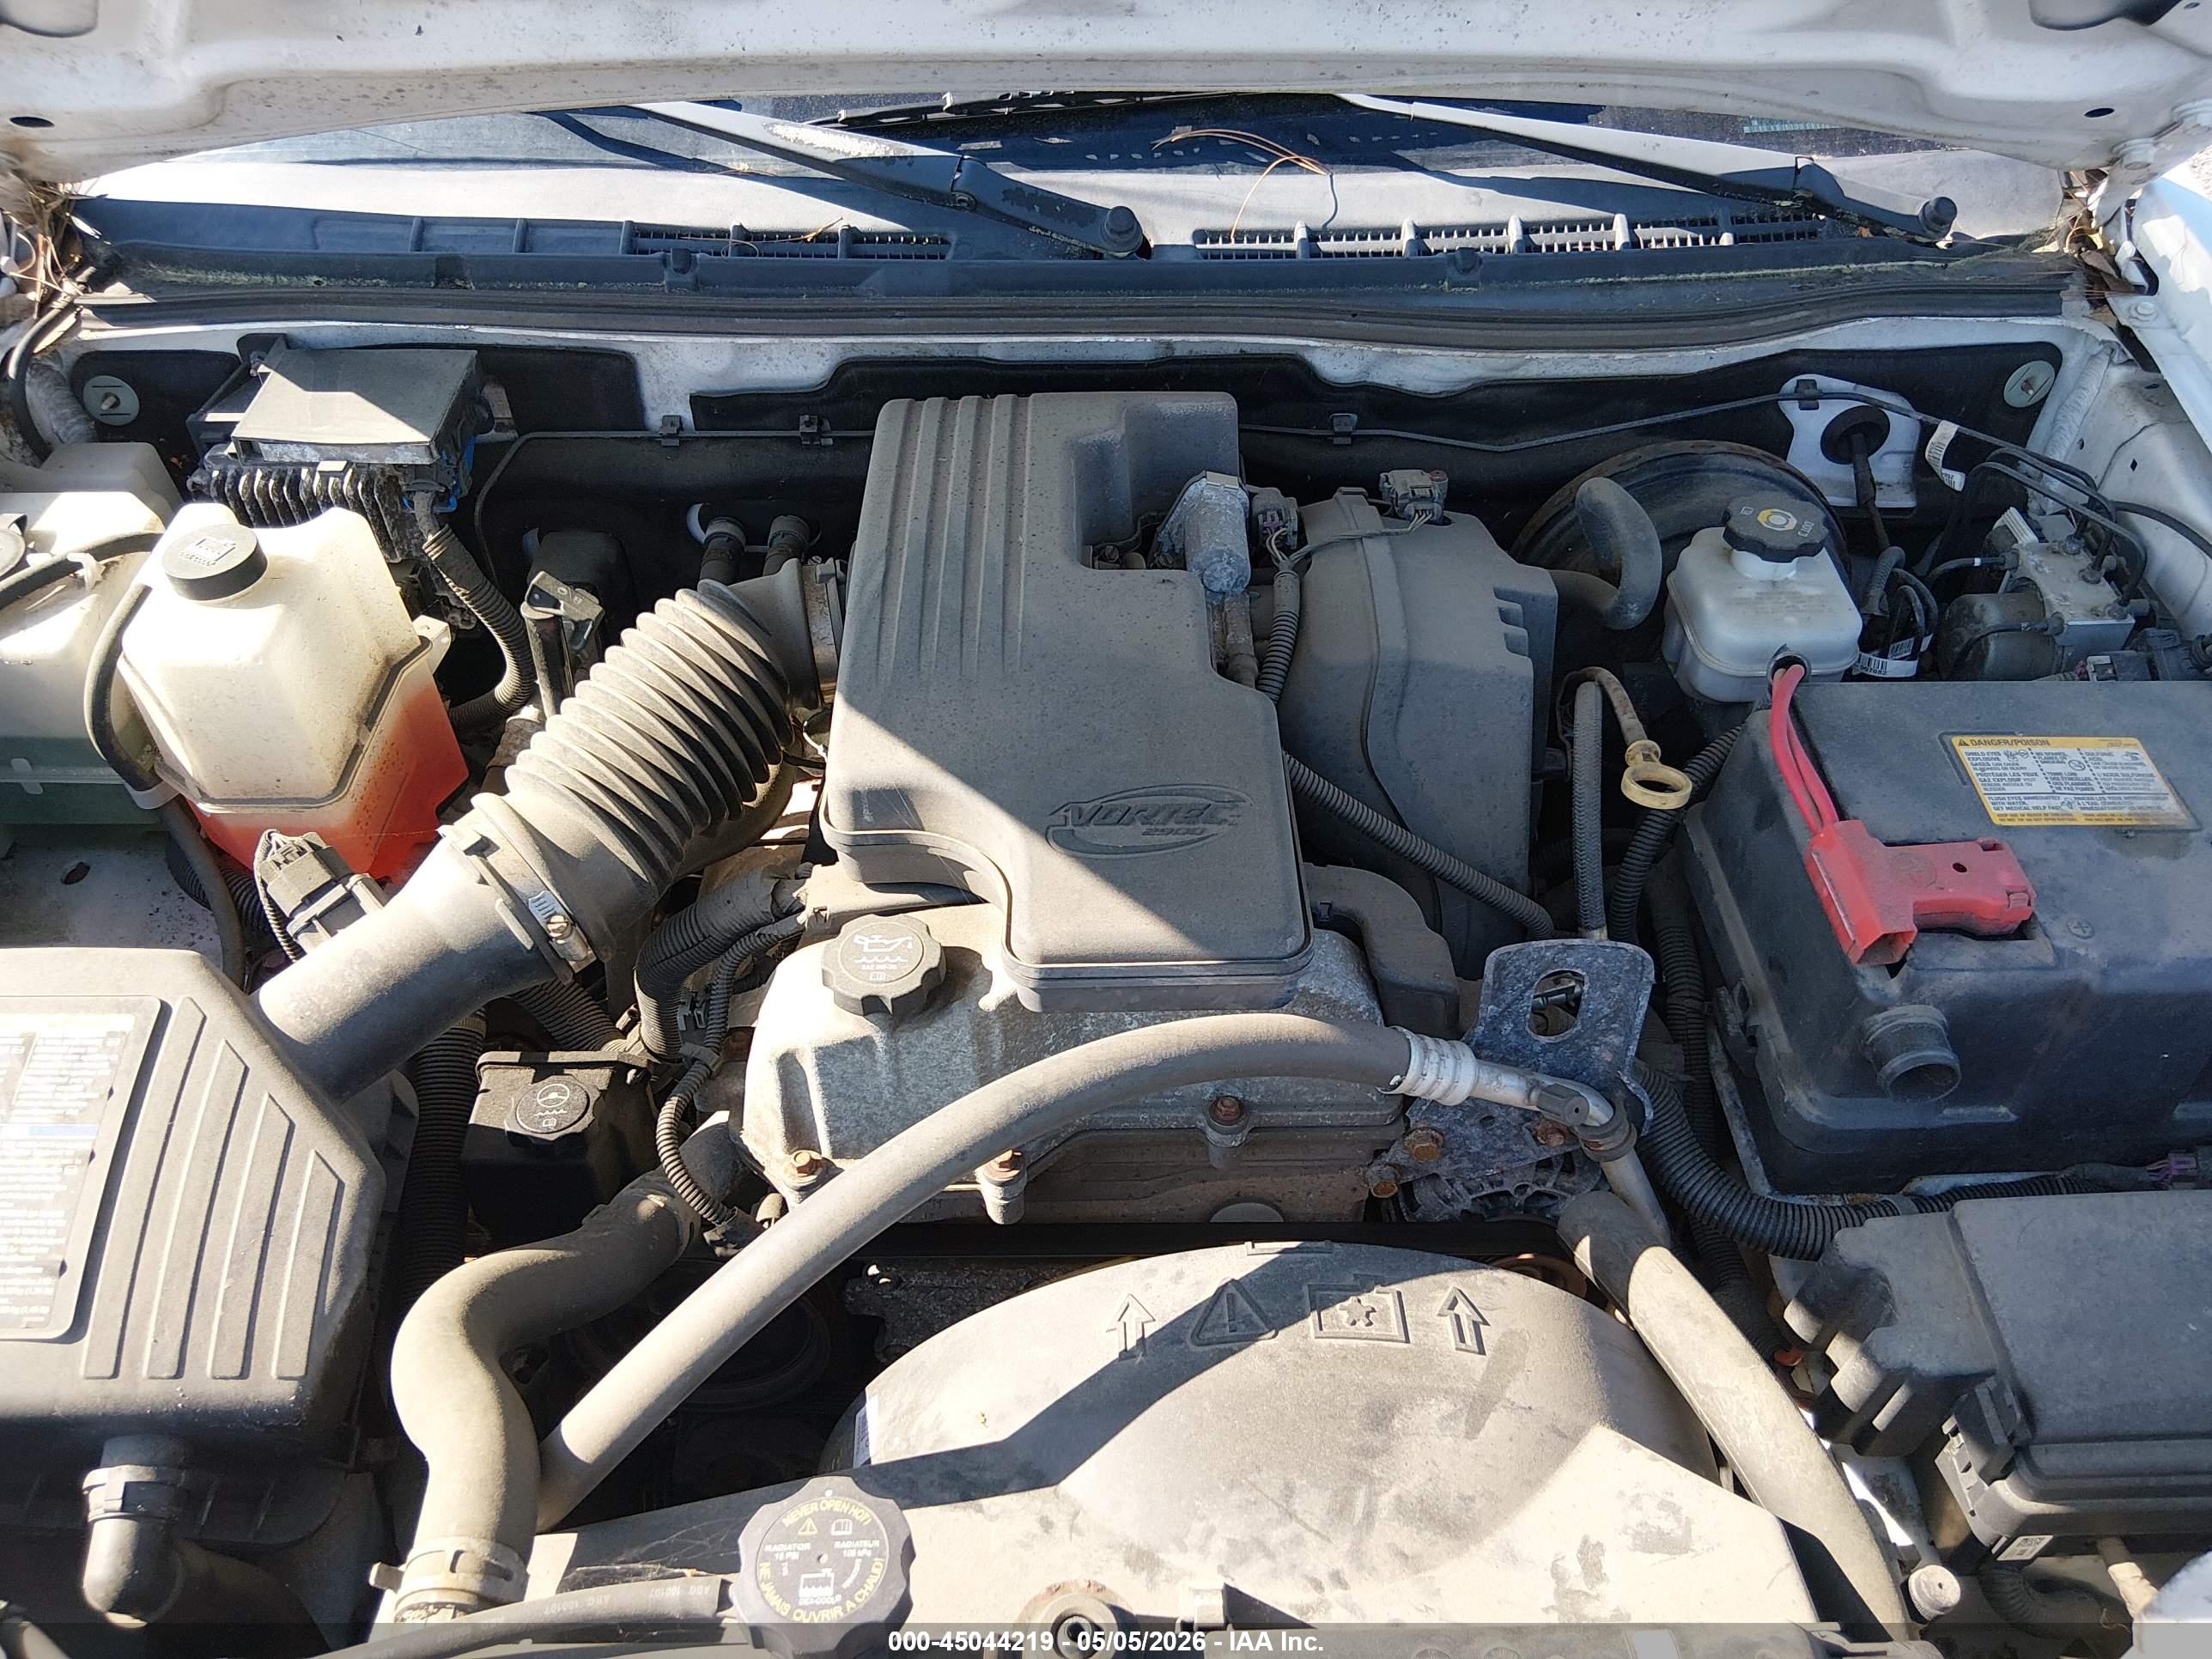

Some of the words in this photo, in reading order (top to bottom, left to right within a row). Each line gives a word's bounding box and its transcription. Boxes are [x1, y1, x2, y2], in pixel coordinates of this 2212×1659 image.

[1970, 738, 2051, 747] DANGER/POISON
[1063, 803, 1240, 826] VORTEC
[781, 1503, 820, 1527] NEVER
[820, 1499, 848, 1515] OPEN
[765, 1542, 811, 1552] RADIATOR
[834, 1539, 880, 1548] RADIATEUR
[758, 1561, 771, 1580] NE
[760, 1580, 792, 1617] JAMAIS
[792, 1603, 845, 1622] OUVRIR
